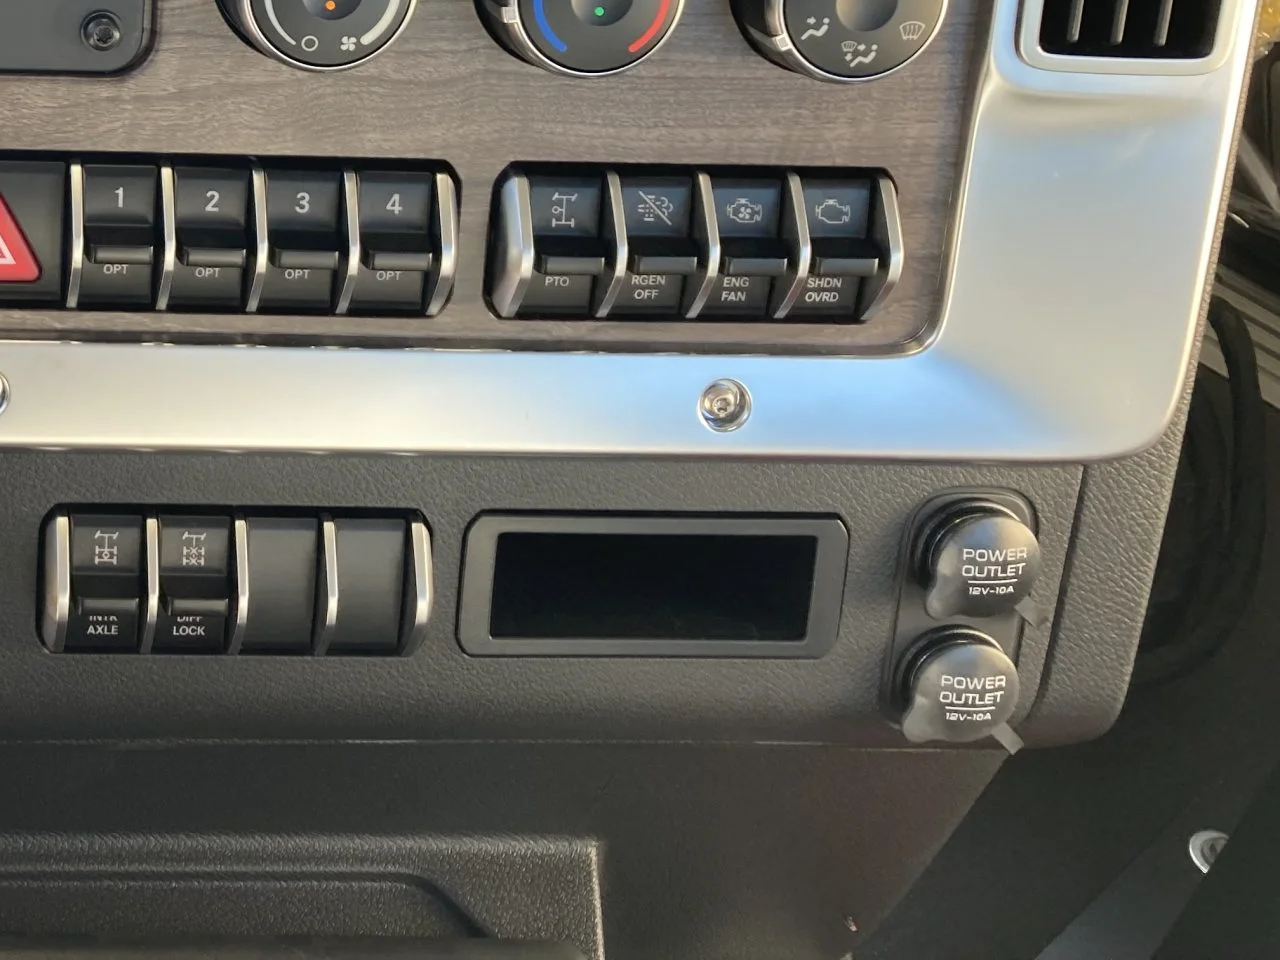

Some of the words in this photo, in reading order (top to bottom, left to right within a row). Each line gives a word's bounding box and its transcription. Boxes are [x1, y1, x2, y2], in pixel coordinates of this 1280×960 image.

[114, 187, 124, 208] 1
[205, 191, 220, 212] 2
[295, 192, 310, 213] 3
[385, 193, 402, 214] 4
[103, 264, 129, 275] OPT
[195, 267, 220, 278] OPT
[284, 269, 309, 280] OPT
[376, 270, 401, 281] OPT
[631, 275, 666, 286] RGEN
[544, 276, 570, 287] PTO
[723, 277, 750, 288] ENG
[807, 277, 842, 288] SHDN
[634, 289, 659, 300] OFF
[721, 291, 746, 302] FAN
[805, 291, 839, 303] OVRD
[962, 547, 1027, 562] POWER
[961, 563, 1026, 578] OUTLET
[968, 585, 1014, 596] 12V-10A
[86, 624, 119, 635] AXLE
[173, 625, 206, 636] LOCK
[941, 675, 1006, 689] POWER
[939, 691, 1004, 705] OUTLET
[945, 712, 992, 721] 12V-10A
